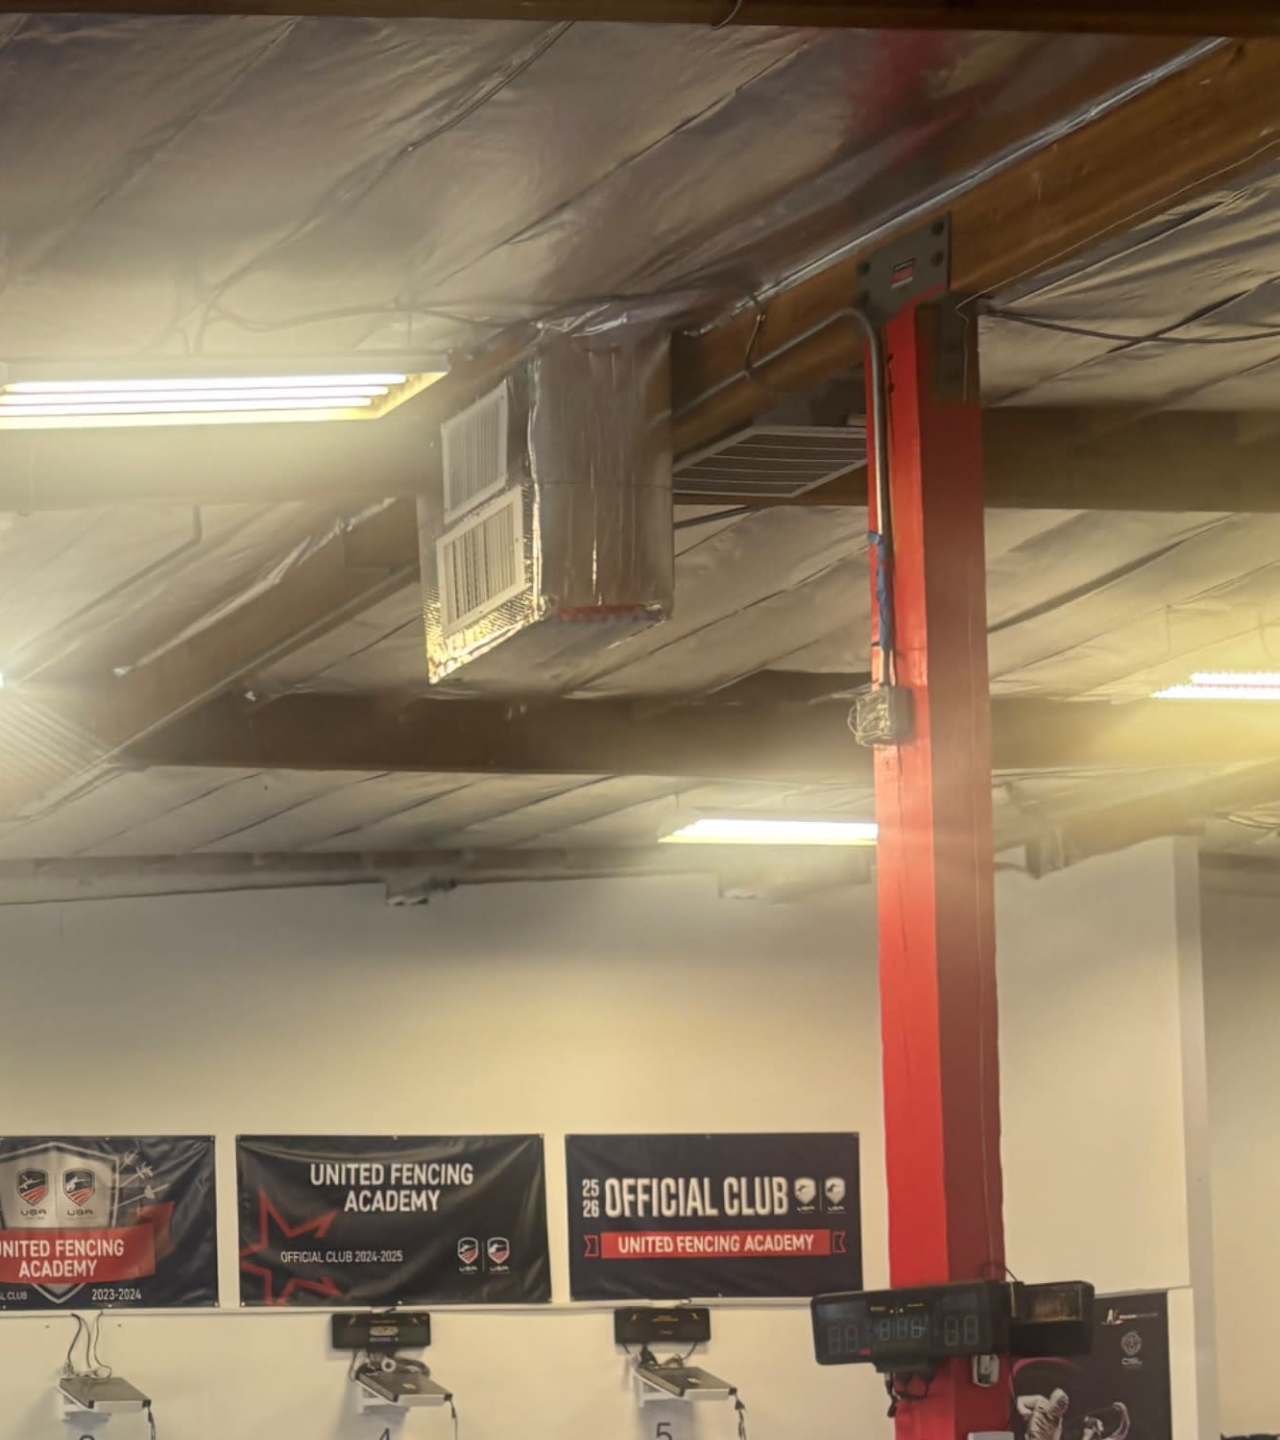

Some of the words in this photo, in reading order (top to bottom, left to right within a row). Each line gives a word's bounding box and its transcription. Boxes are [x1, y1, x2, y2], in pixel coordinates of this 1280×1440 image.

[310, 1163, 385, 1186] UNITED
[390, 1162, 474, 1186] FENCING
[582, 1179, 599, 1198] 25
[605, 1177, 719, 1219] OFFICIAL
[723, 1176, 788, 1217] CLUB
[344, 1189, 441, 1212] ACADEMY
[582, 1200, 599, 1218] 26
[55, 1238, 124, 1257] FENCING
[618, 1236, 674, 1254] UNITED
[677, 1235, 740, 1253] FENCING
[744, 1234, 814, 1252] ACADEMY
[280, 1250, 324, 1262] OFFICIAL
[326, 1250, 353, 1262] CLUB
[355, 1250, 403, 1262] 2024-2025
[18, 1260, 97, 1279] ACADEMY
[7, 1291, 28, 1301] CLUB
[92, 1288, 142, 1300] 2023-2024
